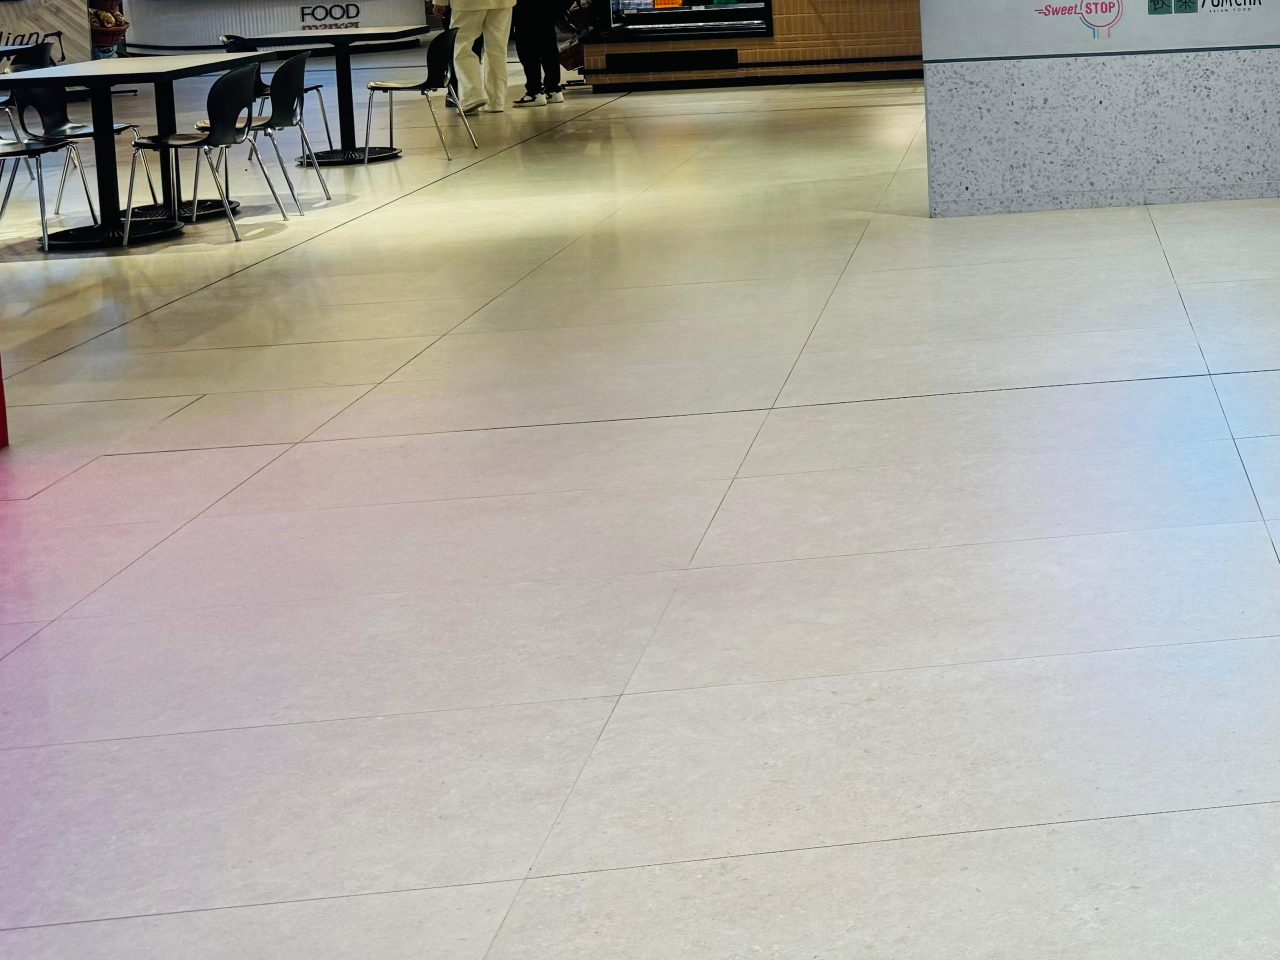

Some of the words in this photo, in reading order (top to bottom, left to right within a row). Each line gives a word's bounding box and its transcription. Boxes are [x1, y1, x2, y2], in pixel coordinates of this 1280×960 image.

[301, 4, 360, 22] FOOD
[1043, 4, 1078, 17] Sweet
[1085, 2, 1116, 15] STOP
